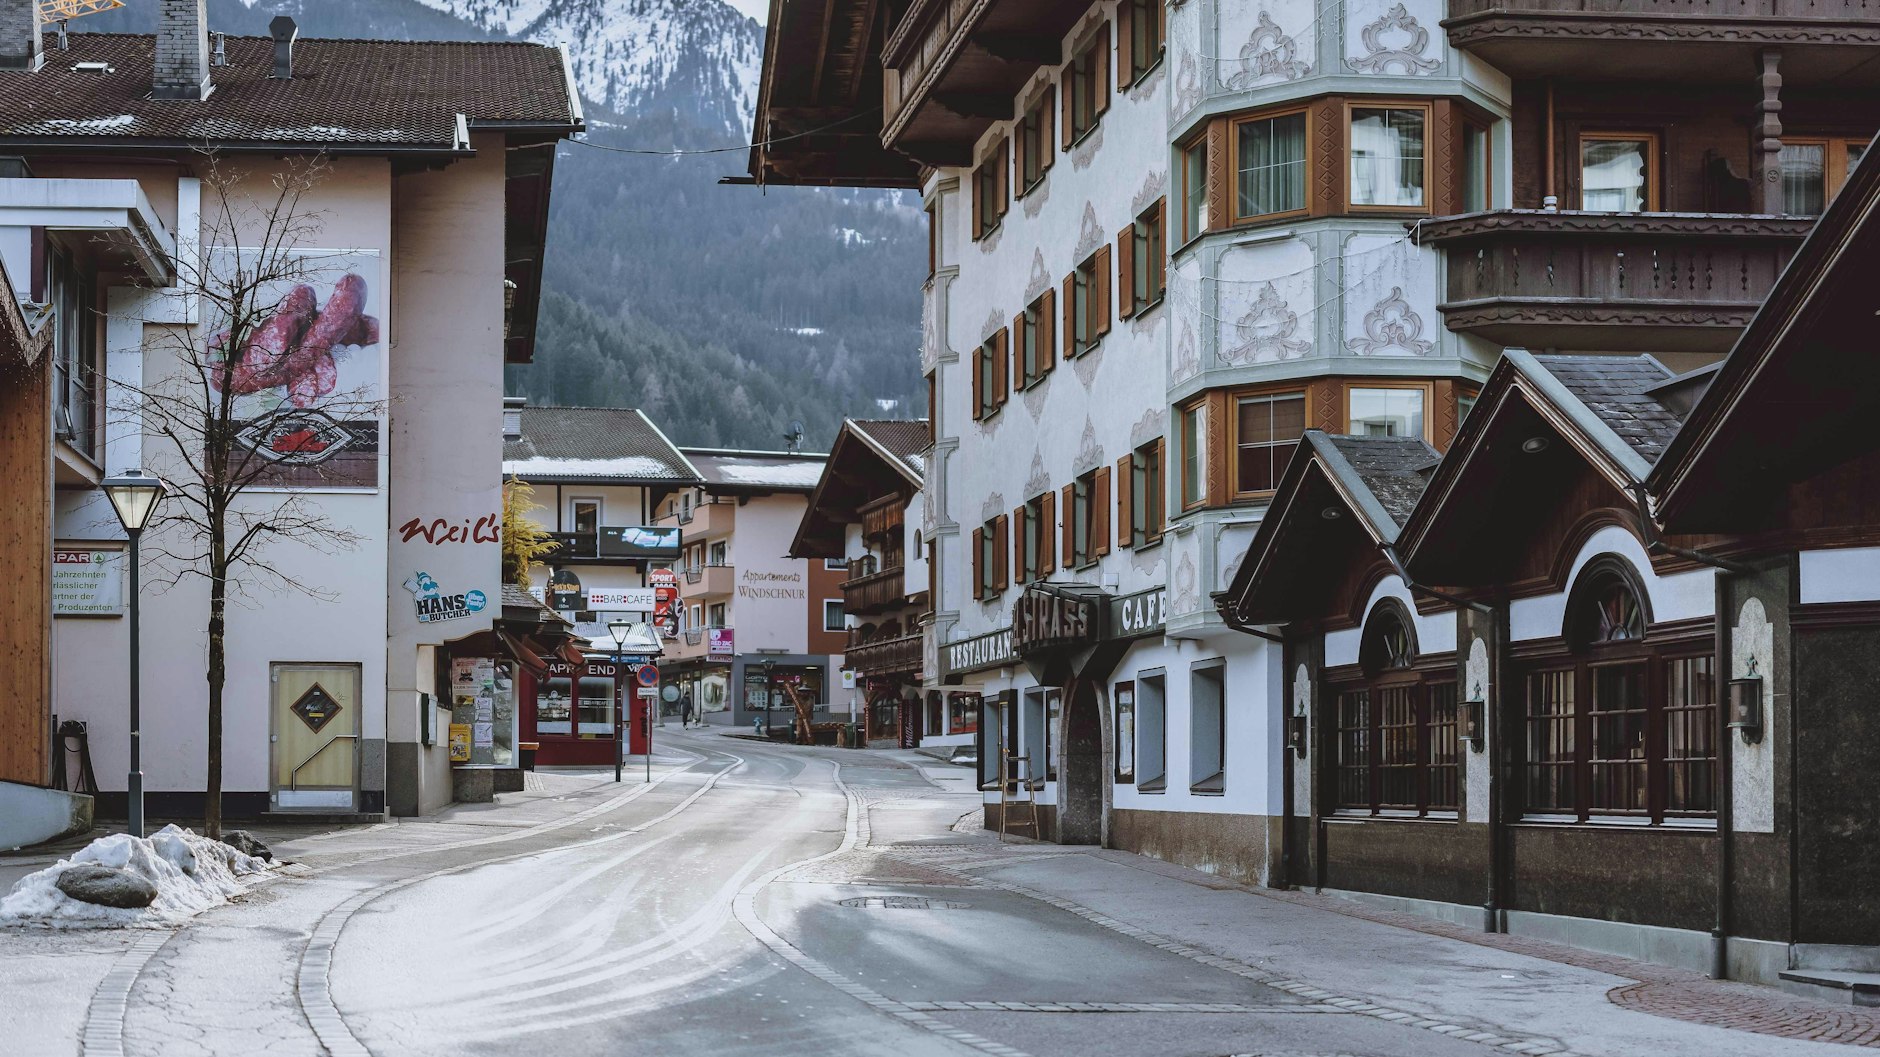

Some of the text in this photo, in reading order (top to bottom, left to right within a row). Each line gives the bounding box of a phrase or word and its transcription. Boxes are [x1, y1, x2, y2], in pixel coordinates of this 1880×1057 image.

[399, 513, 500, 545] Weil's
[54, 553, 90, 562] PAR
[743, 569, 801, 584] Appartements
[417, 595, 466, 615] HANS
[429, 609, 471, 622] BUTCHER
[1023, 588, 1088, 643] STRASS
[1122, 591, 1166, 631] CAFE
[950, 631, 1016, 670] RESTAURAN
